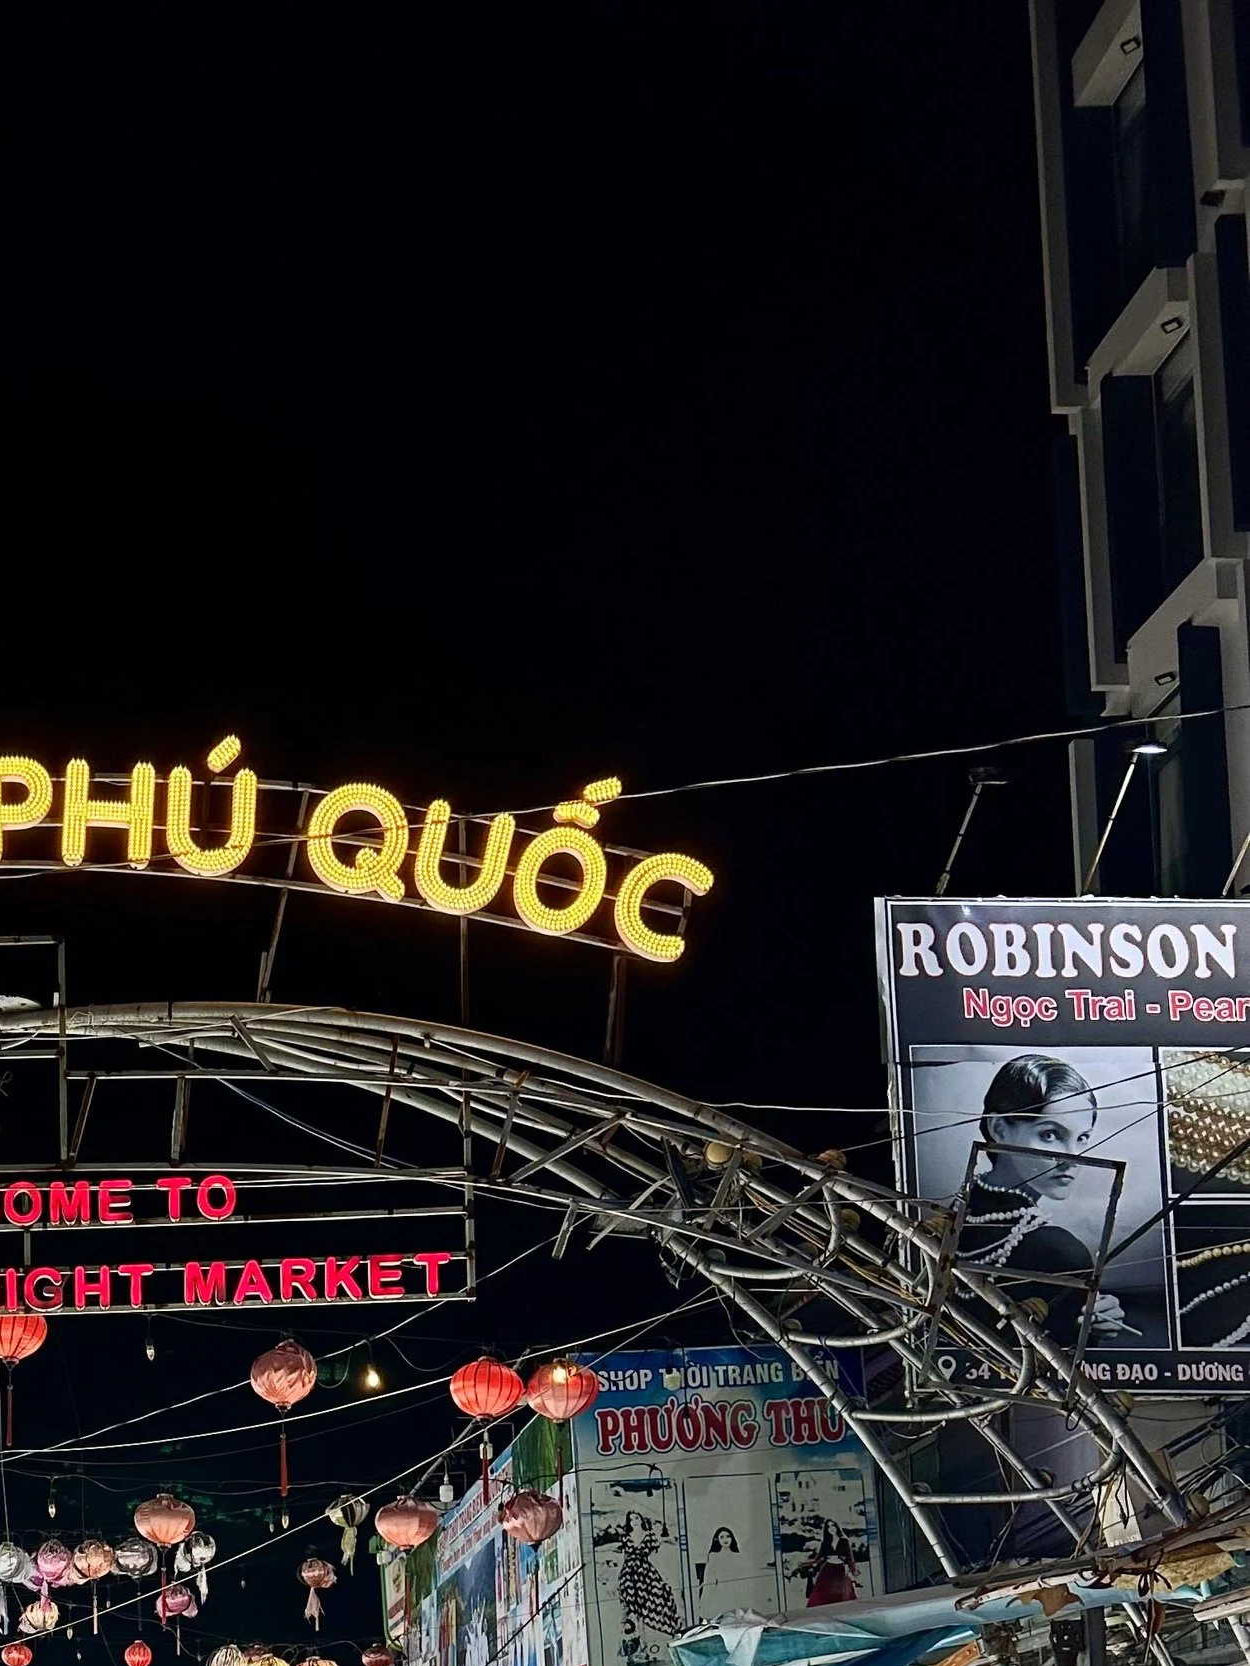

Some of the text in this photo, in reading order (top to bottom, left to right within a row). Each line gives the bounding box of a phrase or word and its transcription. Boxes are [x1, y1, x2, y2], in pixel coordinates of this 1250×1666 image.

[301, 776, 713, 961] QUỐC
[896, 922, 1238, 979] ROBINSON
[962, 987, 1058, 1028] Ngọc
[1065, 988, 1137, 1022] Trai
[156, 1176, 238, 1220] TO
[184, 1251, 454, 1304] MARKET
[598, 1361, 784, 1392] SHOP TRANG
[1117, 1364, 1158, 1384] ĐẠO
[1177, 1361, 1244, 1382] DƯƠNG
[595, 1394, 758, 1456] PHƯƠNG
